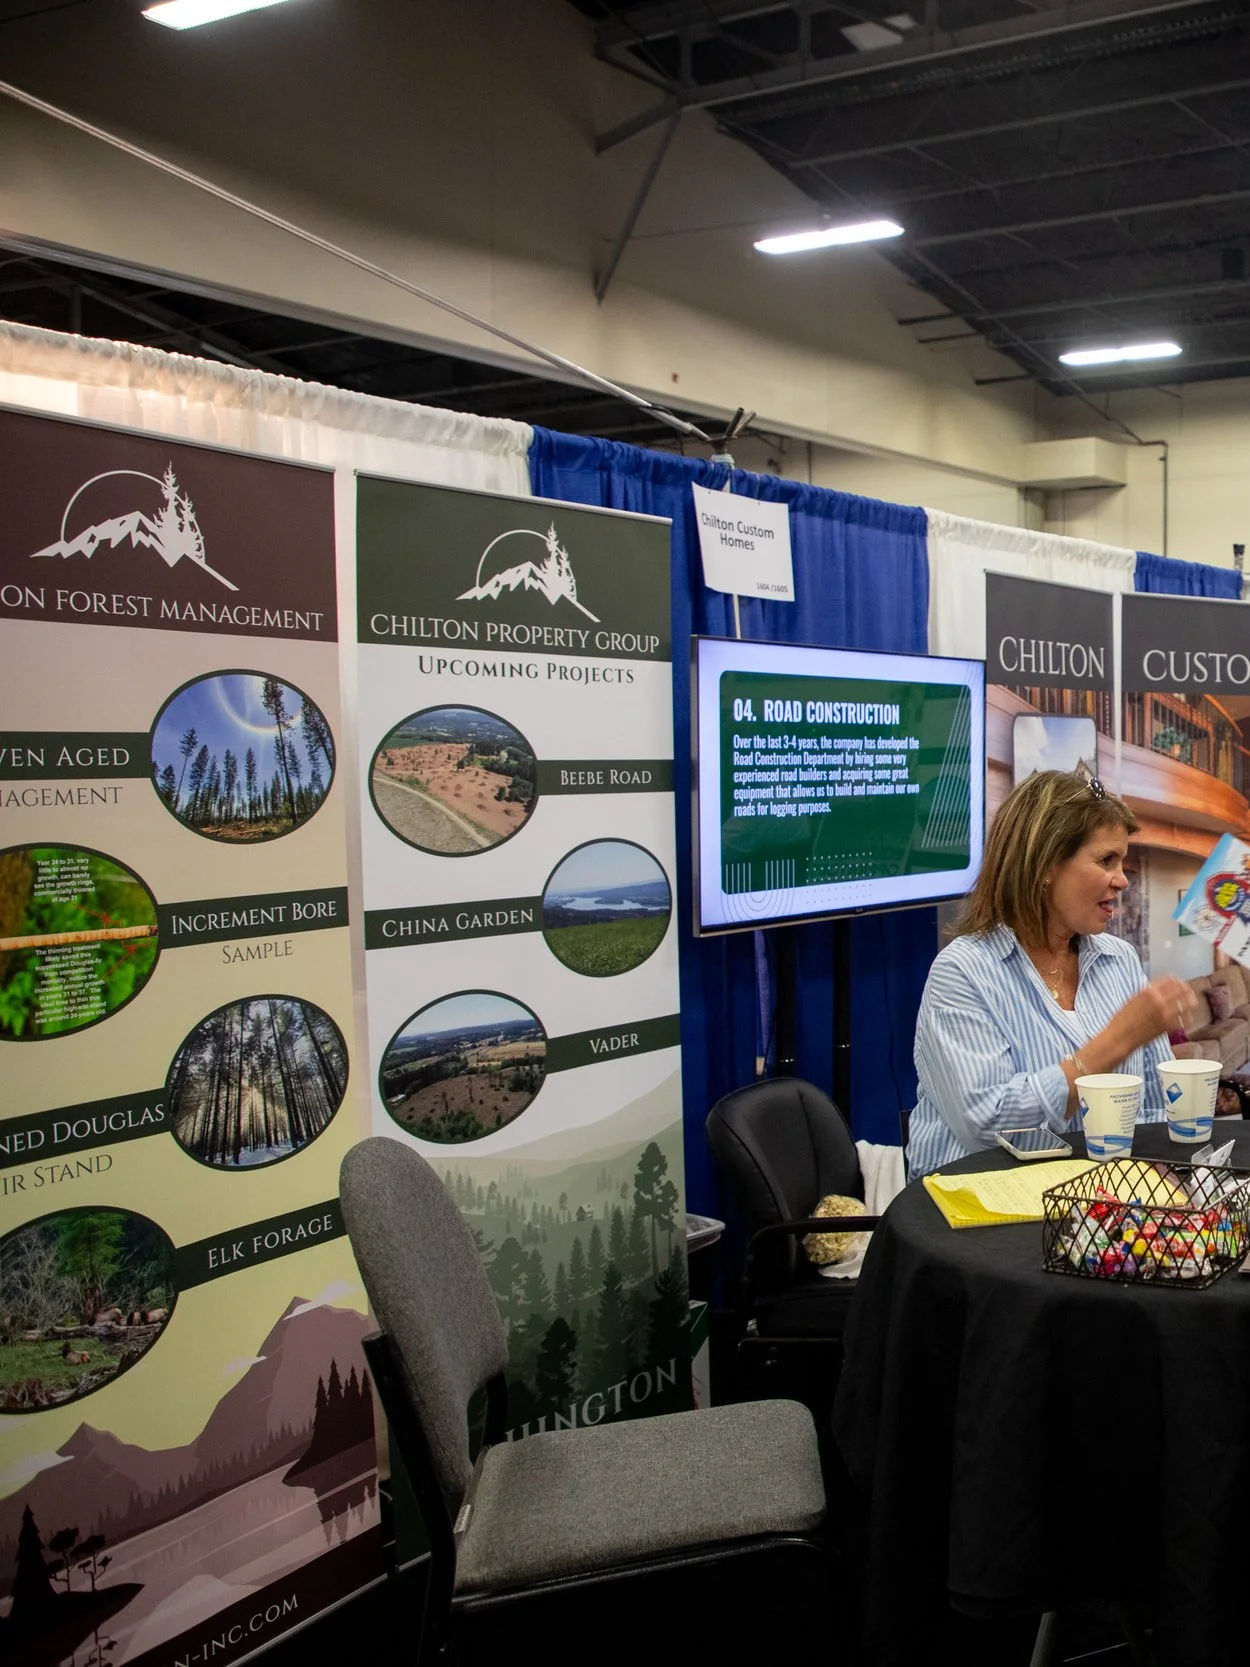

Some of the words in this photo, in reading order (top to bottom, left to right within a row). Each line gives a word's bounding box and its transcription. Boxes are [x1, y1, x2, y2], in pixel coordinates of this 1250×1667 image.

[701, 512, 735, 532] Chilton
[737, 521, 775, 540] Custom
[720, 532, 755, 551] Homes
[56, 590, 153, 617] FOREST
[160, 600, 324, 631] MANAGEMENT
[370, 613, 479, 642] CHILTON
[485, 622, 590, 649] PROPERTY
[595, 631, 660, 654] GROUP
[998, 634, 1106, 679] CHILTON
[418, 655, 539, 679] UPCOMING
[546, 662, 635, 686] PROJECTS
[733, 698, 757, 722] 04.
[763, 699, 802, 723] ROAD
[806, 701, 900, 725] CONSTRUCTION
[56, 746, 130, 766] AGED
[733, 734, 751, 749] Over
[753, 735, 766, 749] the
[767, 735, 782, 749] last
[783, 735, 797, 749] 3-4
[798, 737, 820, 751] years,
[820, 735, 832, 749] the
[833, 738, 863, 751] company
[864, 735, 876, 749] has
[876, 735, 909, 752] developed
[909, 736, 920, 749] the
[733, 751, 753, 766] Road
[754, 751, 802, 766] Construction
[803, 751, 844, 768] Department
[845, 752, 854, 767] by
[854, 752, 874, 767] hiring
[875, 754, 892, 765] some
[892, 754, 907, 767] very
[560, 769, 604, 786] BEEBE
[609, 770, 652, 785] ROAD
[733, 767, 780, 785] experienced
[780, 767, 798, 782] road
[798, 767, 828, 782] builders
[828, 767, 842, 781] and
[842, 767, 873, 783] acquiring
[873, 769, 891, 780] some
[891, 767, 909, 782] great
[0, 786, 123, 807] AGEMENT
[733, 785, 775, 802] equipment
[775, 785, 791, 799] that
[792, 784, 815, 798] allows
[816, 786, 825, 797] us
[826, 784, 834, 797] to
[835, 782, 851, 796] build
[852, 782, 865, 796] and
[866, 782, 895, 795] maintain
[895, 783, 907, 794] our
[906, 783, 920, 794] own
[733, 802, 756, 817] roads
[757, 802, 768, 816] for
[769, 801, 797, 818] logging
[798, 802, 832, 817] purposes.
[171, 905, 286, 935] INCREMENT
[291, 901, 337, 922] BORE
[381, 920, 450, 937] CHINA
[455, 908, 534, 930] GARDEN
[222, 940, 294, 965] SAMPLE
[589, 1033, 639, 1054] VADER
[53, 1103, 165, 1145] DOUGLAS
[33, 1153, 113, 1188] STAND
[208, 1241, 245, 1269] ELK
[252, 1214, 333, 1253] FORAGE
